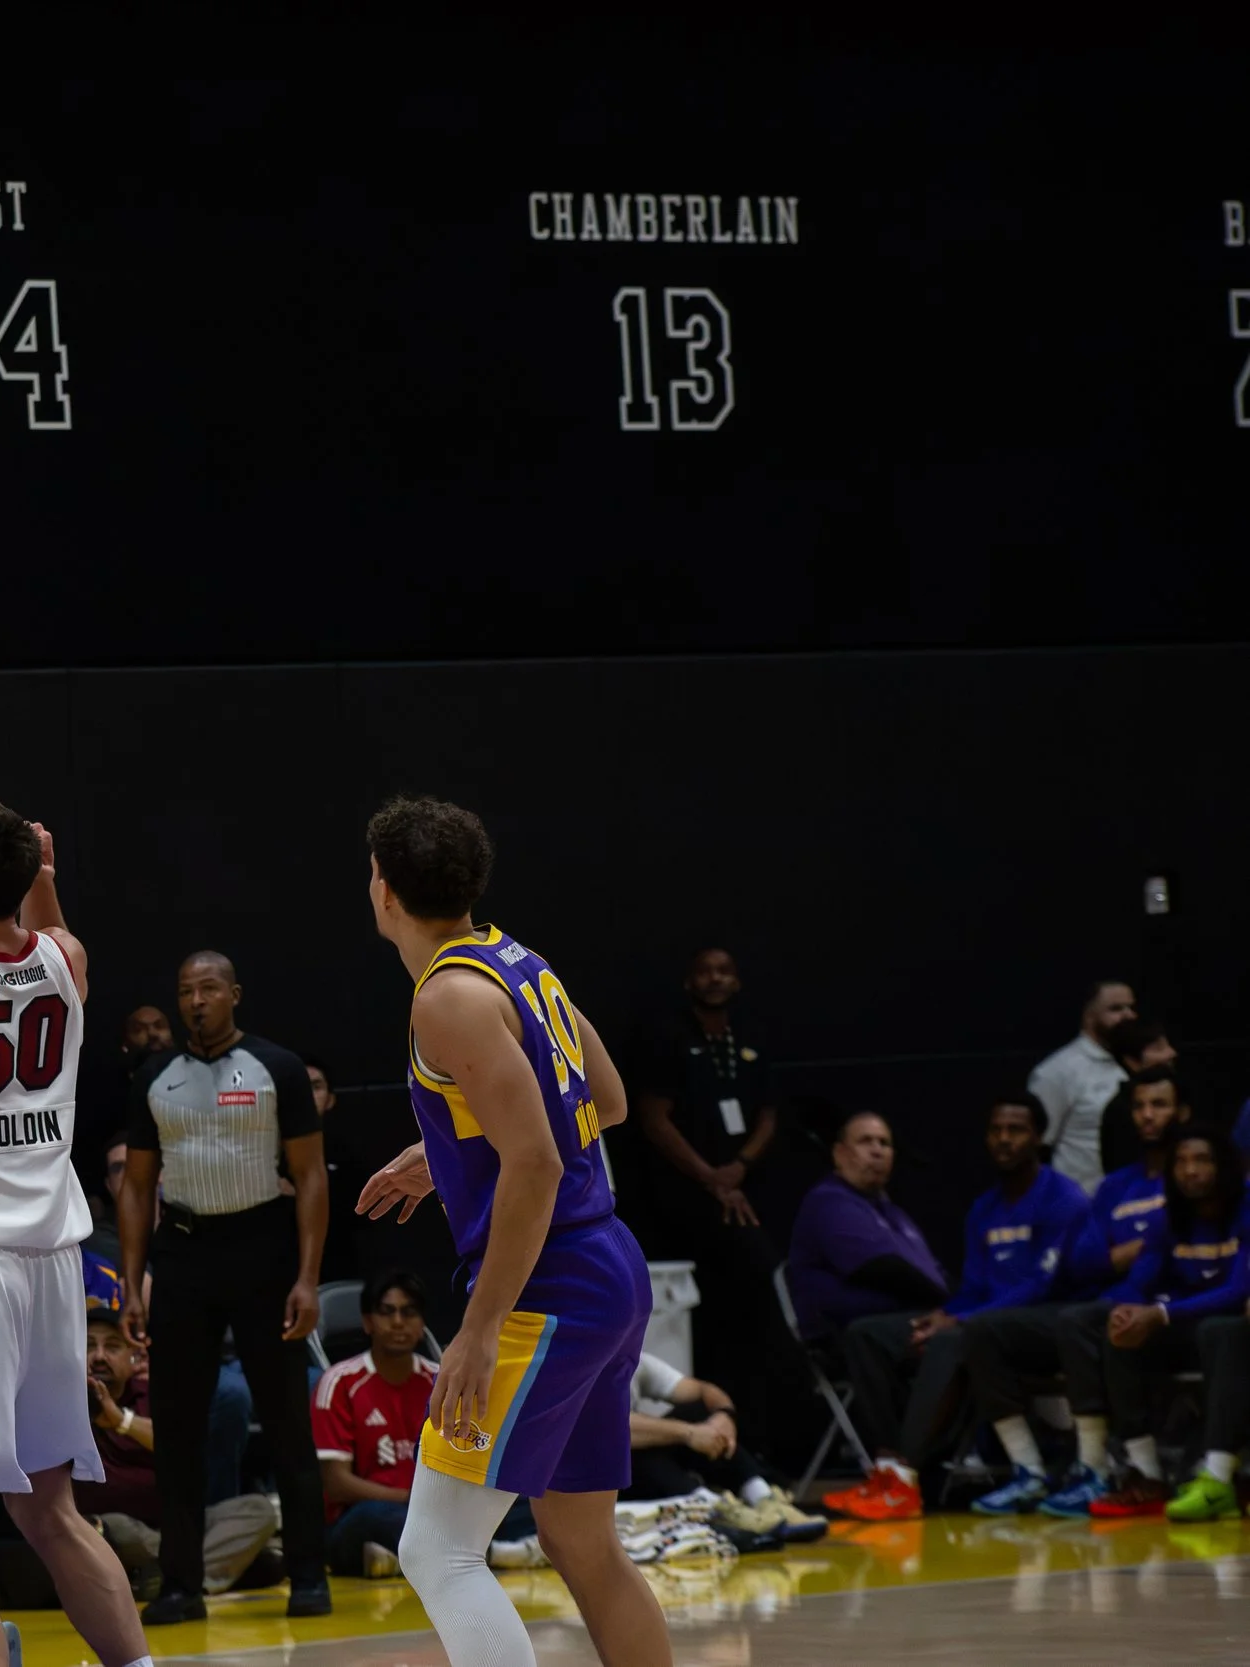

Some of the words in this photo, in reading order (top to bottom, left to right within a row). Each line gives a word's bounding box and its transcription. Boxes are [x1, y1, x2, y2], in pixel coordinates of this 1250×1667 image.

[528, 191, 799, 245] CHAMBERLAIN
[612, 286, 736, 431] 13
[15, 963, 48, 986] LEAGUE
